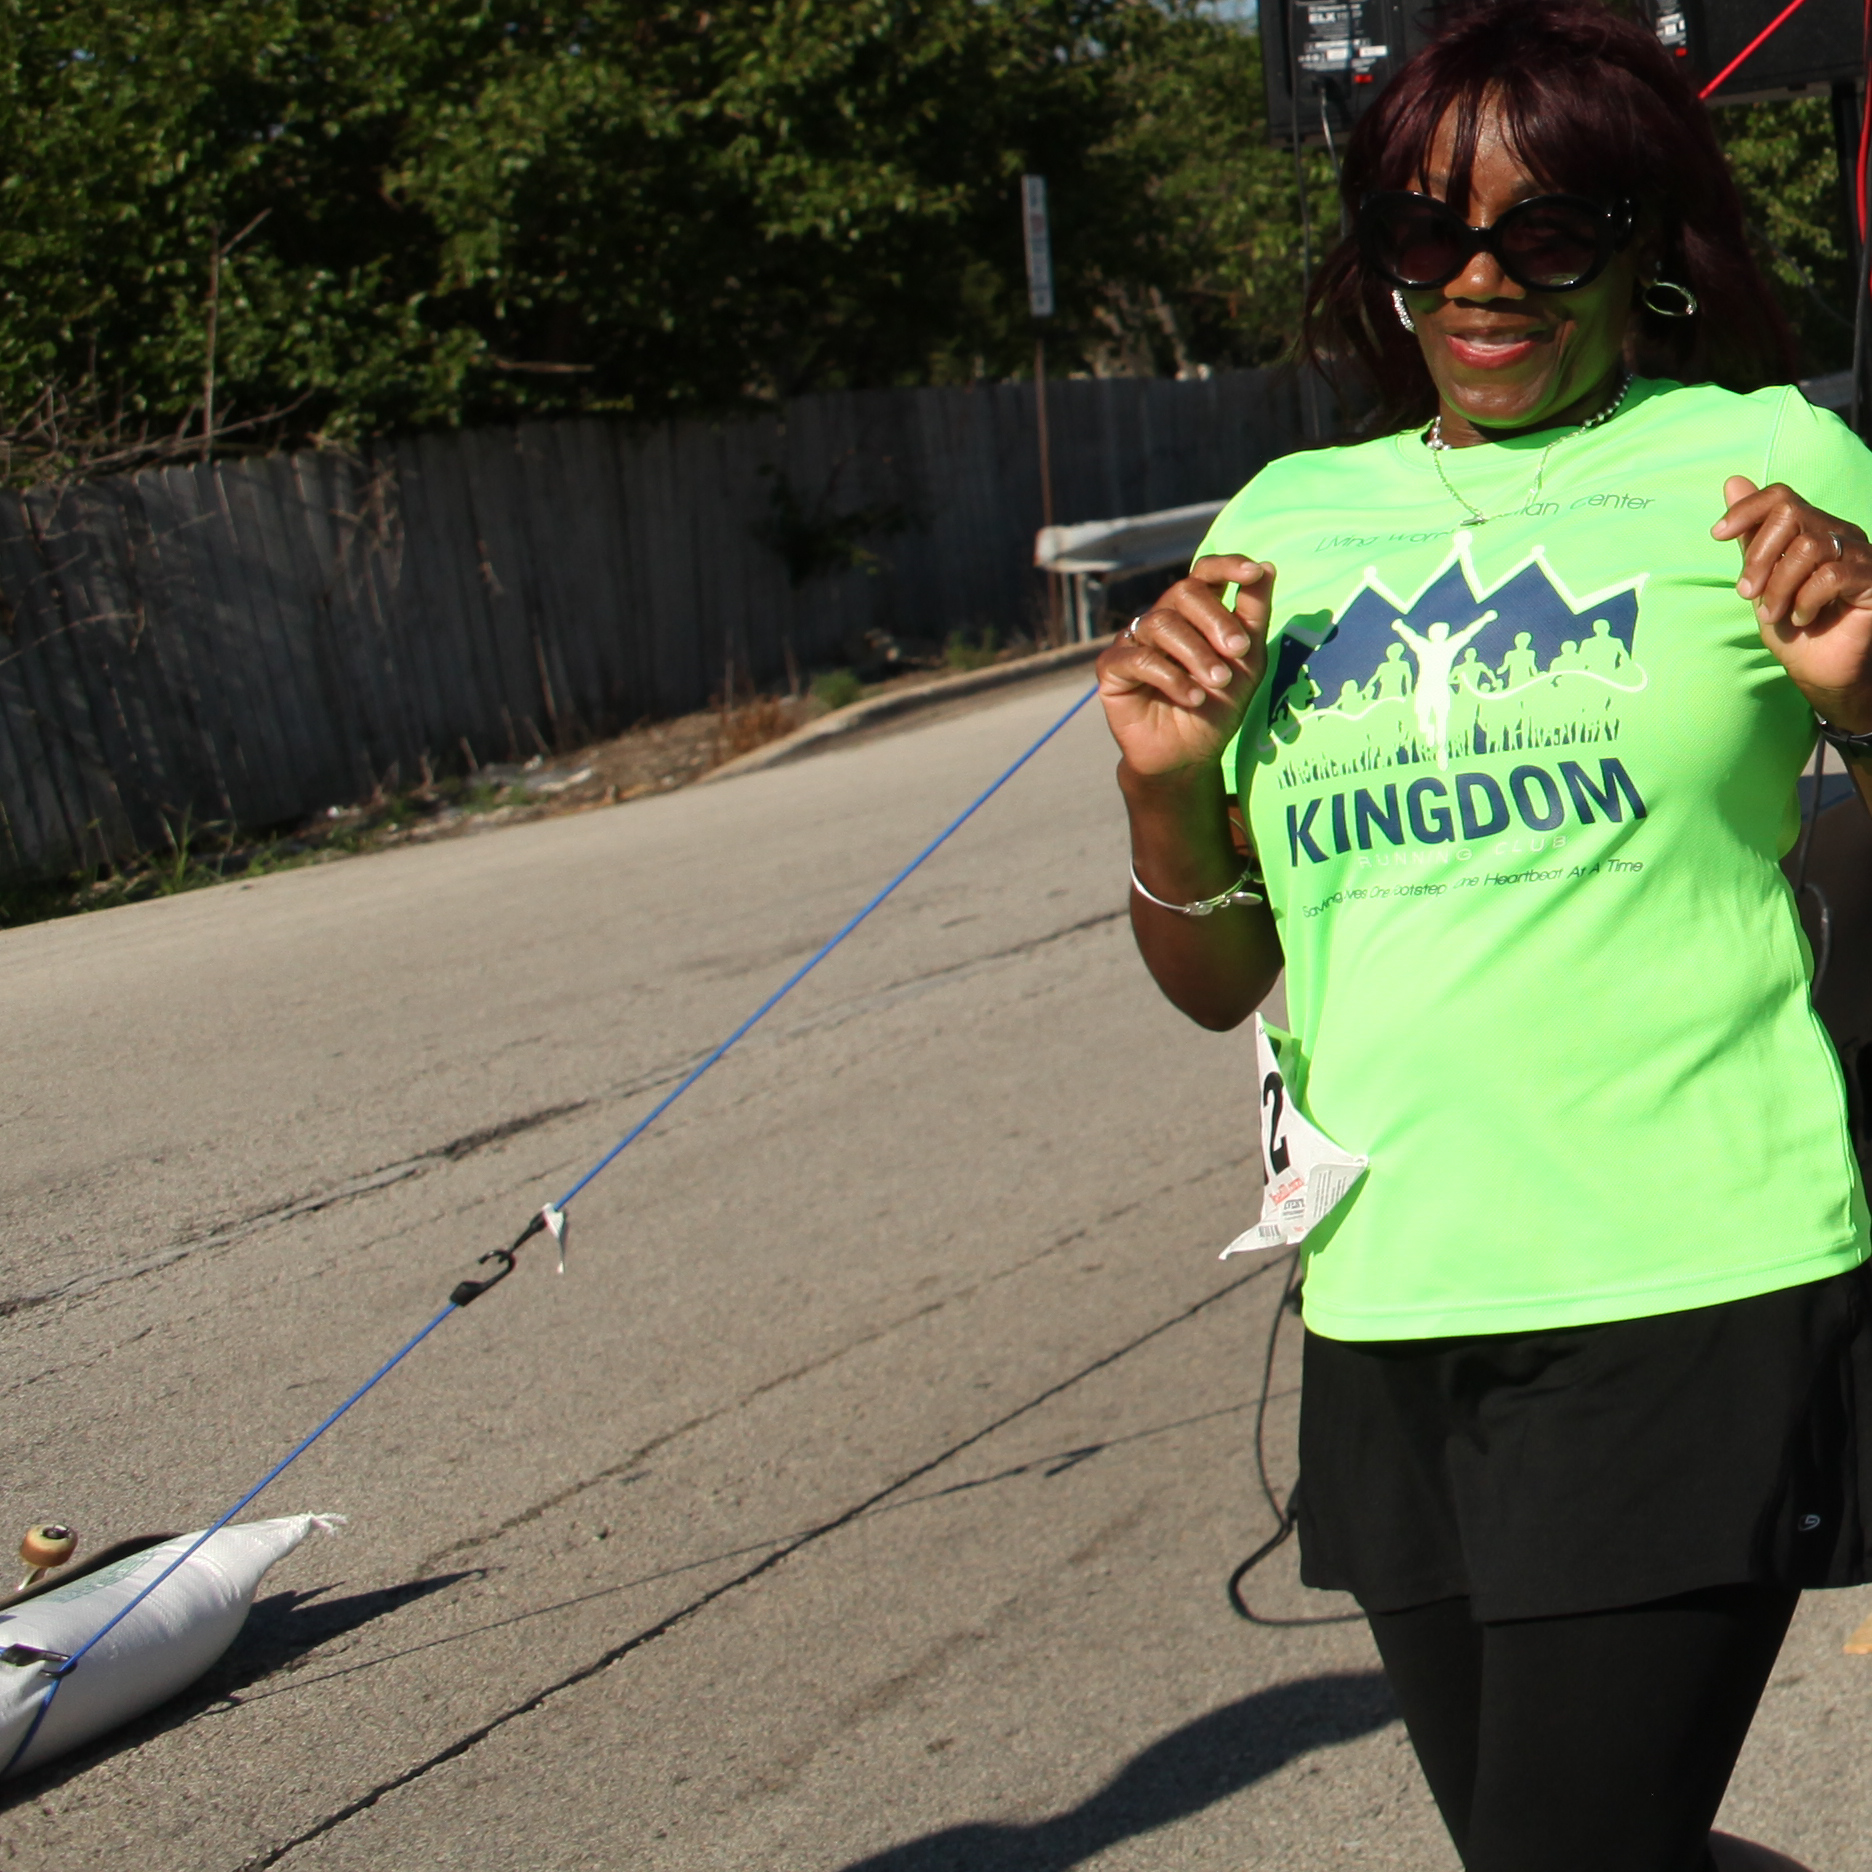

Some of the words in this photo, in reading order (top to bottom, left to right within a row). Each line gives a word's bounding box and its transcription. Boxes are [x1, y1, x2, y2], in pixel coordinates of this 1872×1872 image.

[1286, 757, 1648, 868] KINGDOM
[1357, 847, 1474, 869] RUNNING
[1495, 835, 1568, 856] CLUB
[1607, 858, 1644, 874] Time
